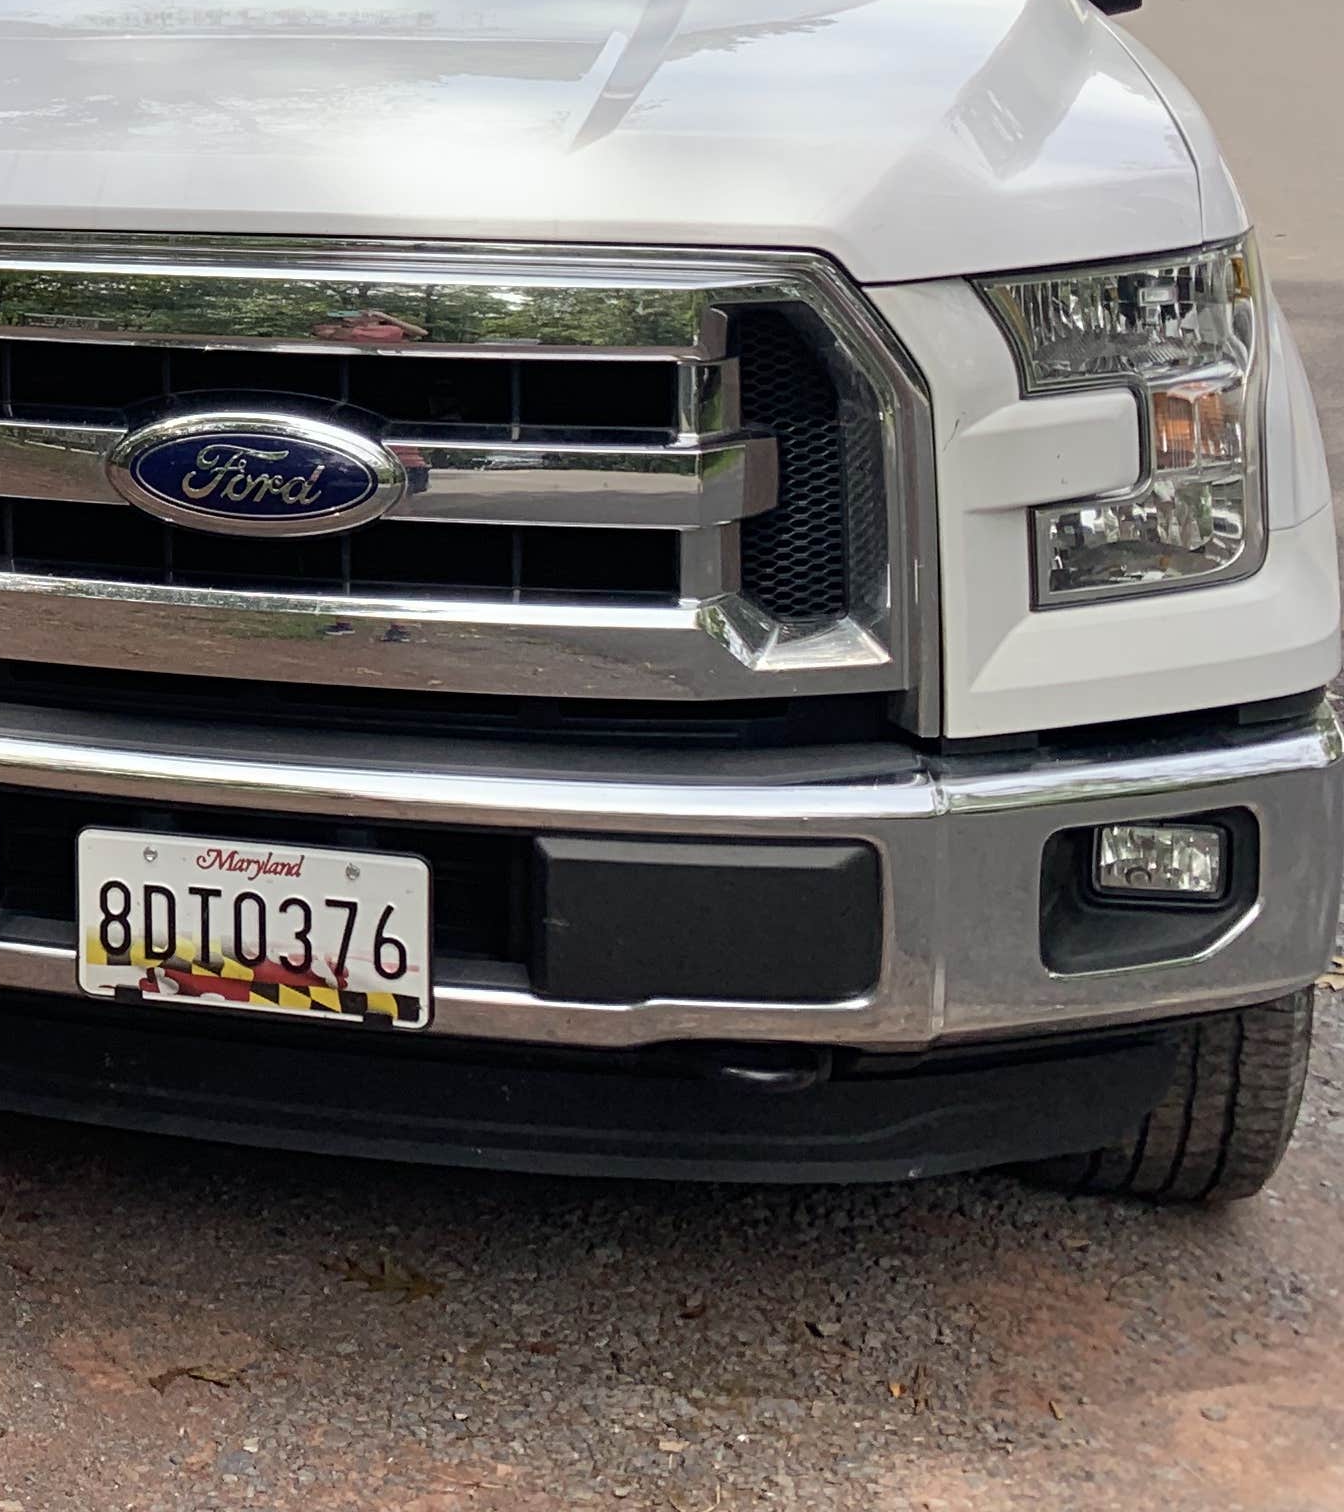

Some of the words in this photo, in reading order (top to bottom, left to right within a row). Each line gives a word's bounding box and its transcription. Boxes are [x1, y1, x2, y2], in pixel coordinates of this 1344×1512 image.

[182, 443, 325, 505] Ford
[196, 848, 305, 881] Maryland
[99, 880, 408, 980] 8DT0376
